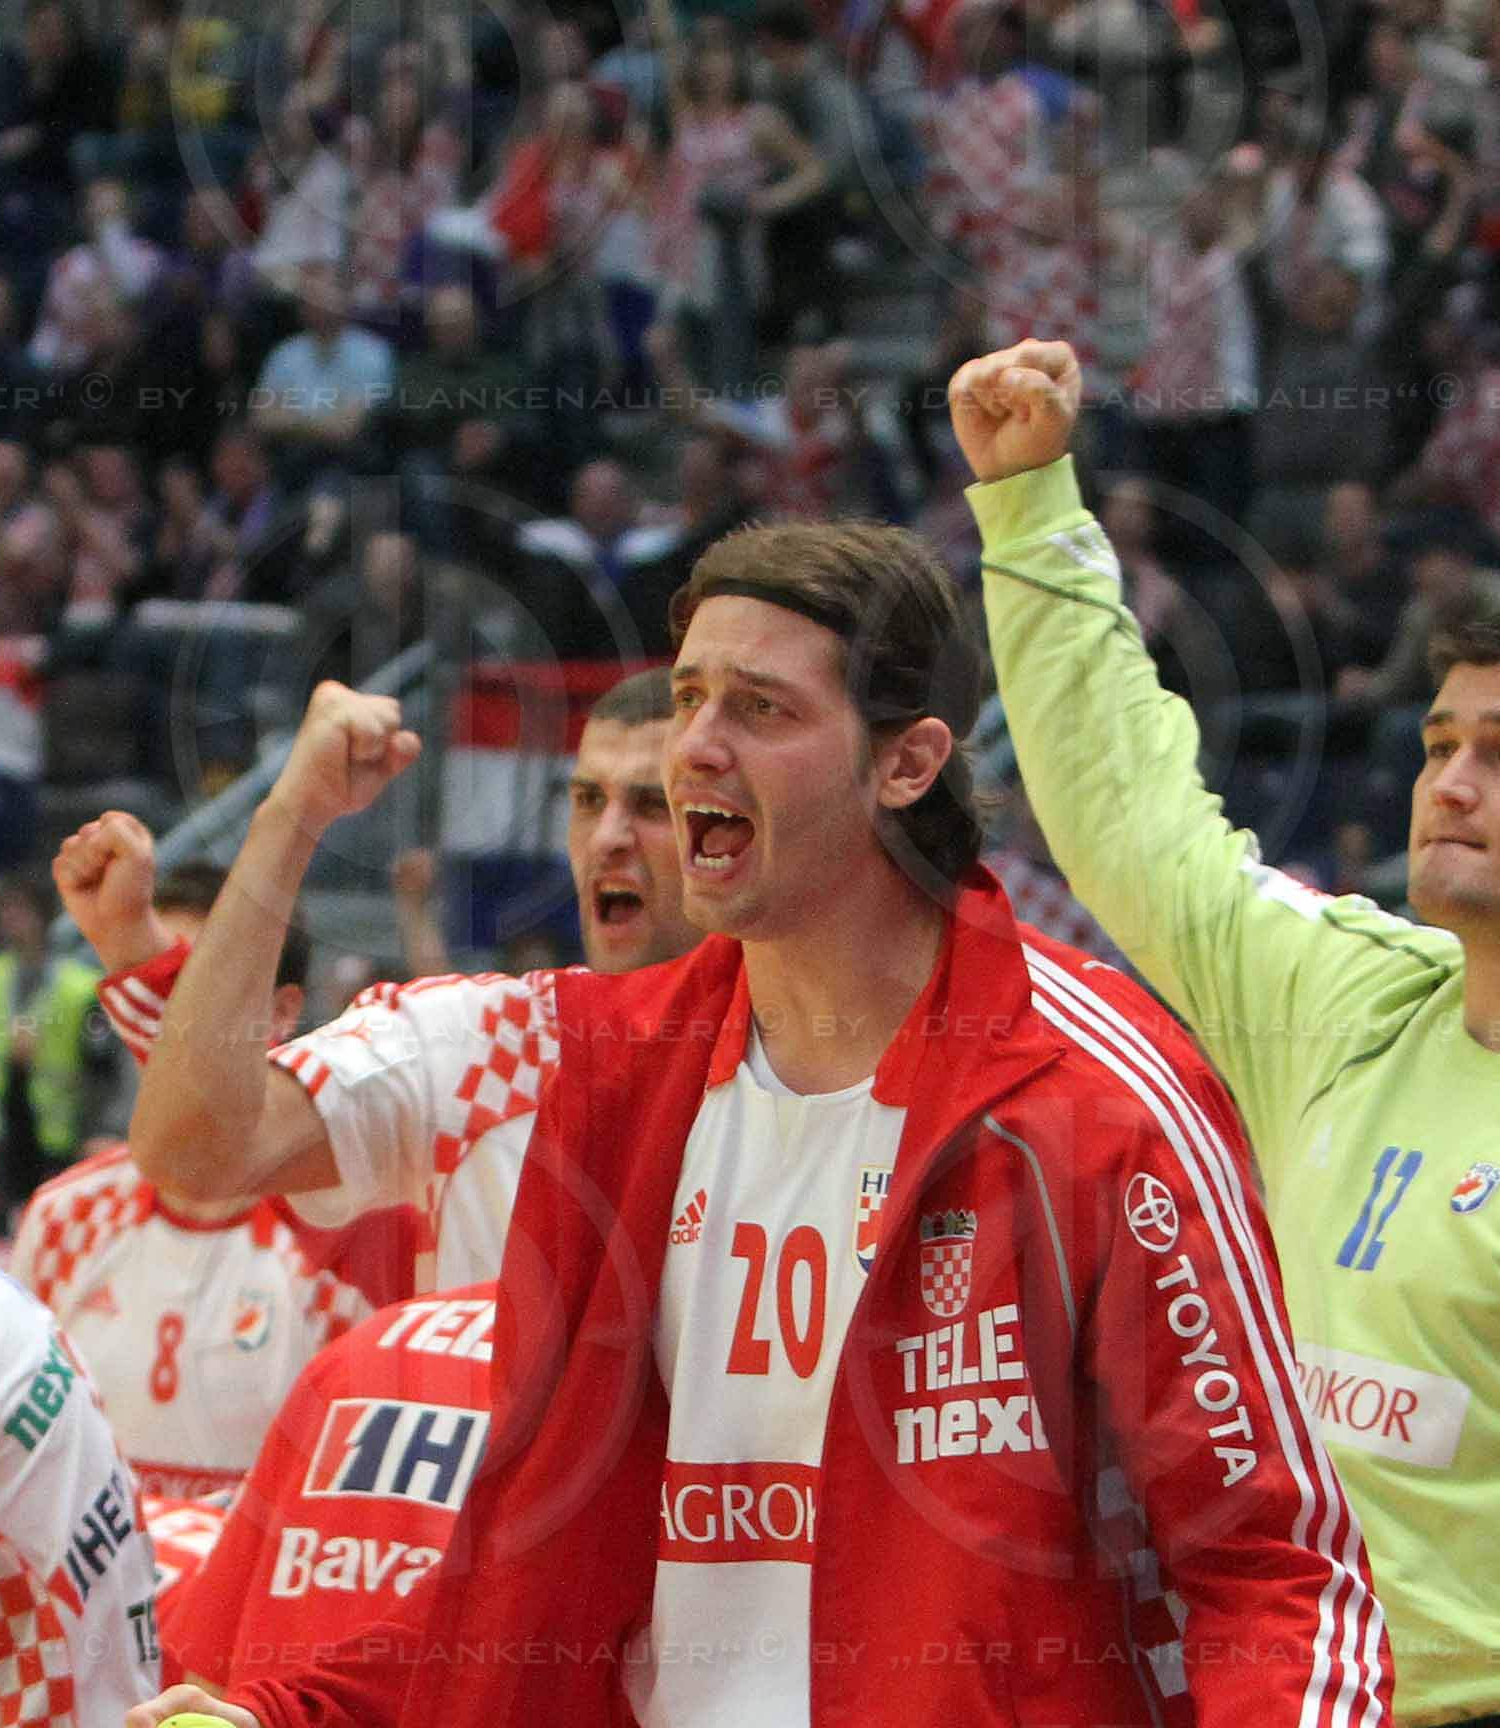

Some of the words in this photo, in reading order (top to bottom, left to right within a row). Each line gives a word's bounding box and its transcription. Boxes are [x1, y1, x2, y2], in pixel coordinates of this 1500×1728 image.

[151, 1314, 184, 1404] 8
[725, 1221, 827, 1380] 20
[895, 1303, 1026, 1394] TELE
[1155, 1253, 1258, 1489] TOYOTA
